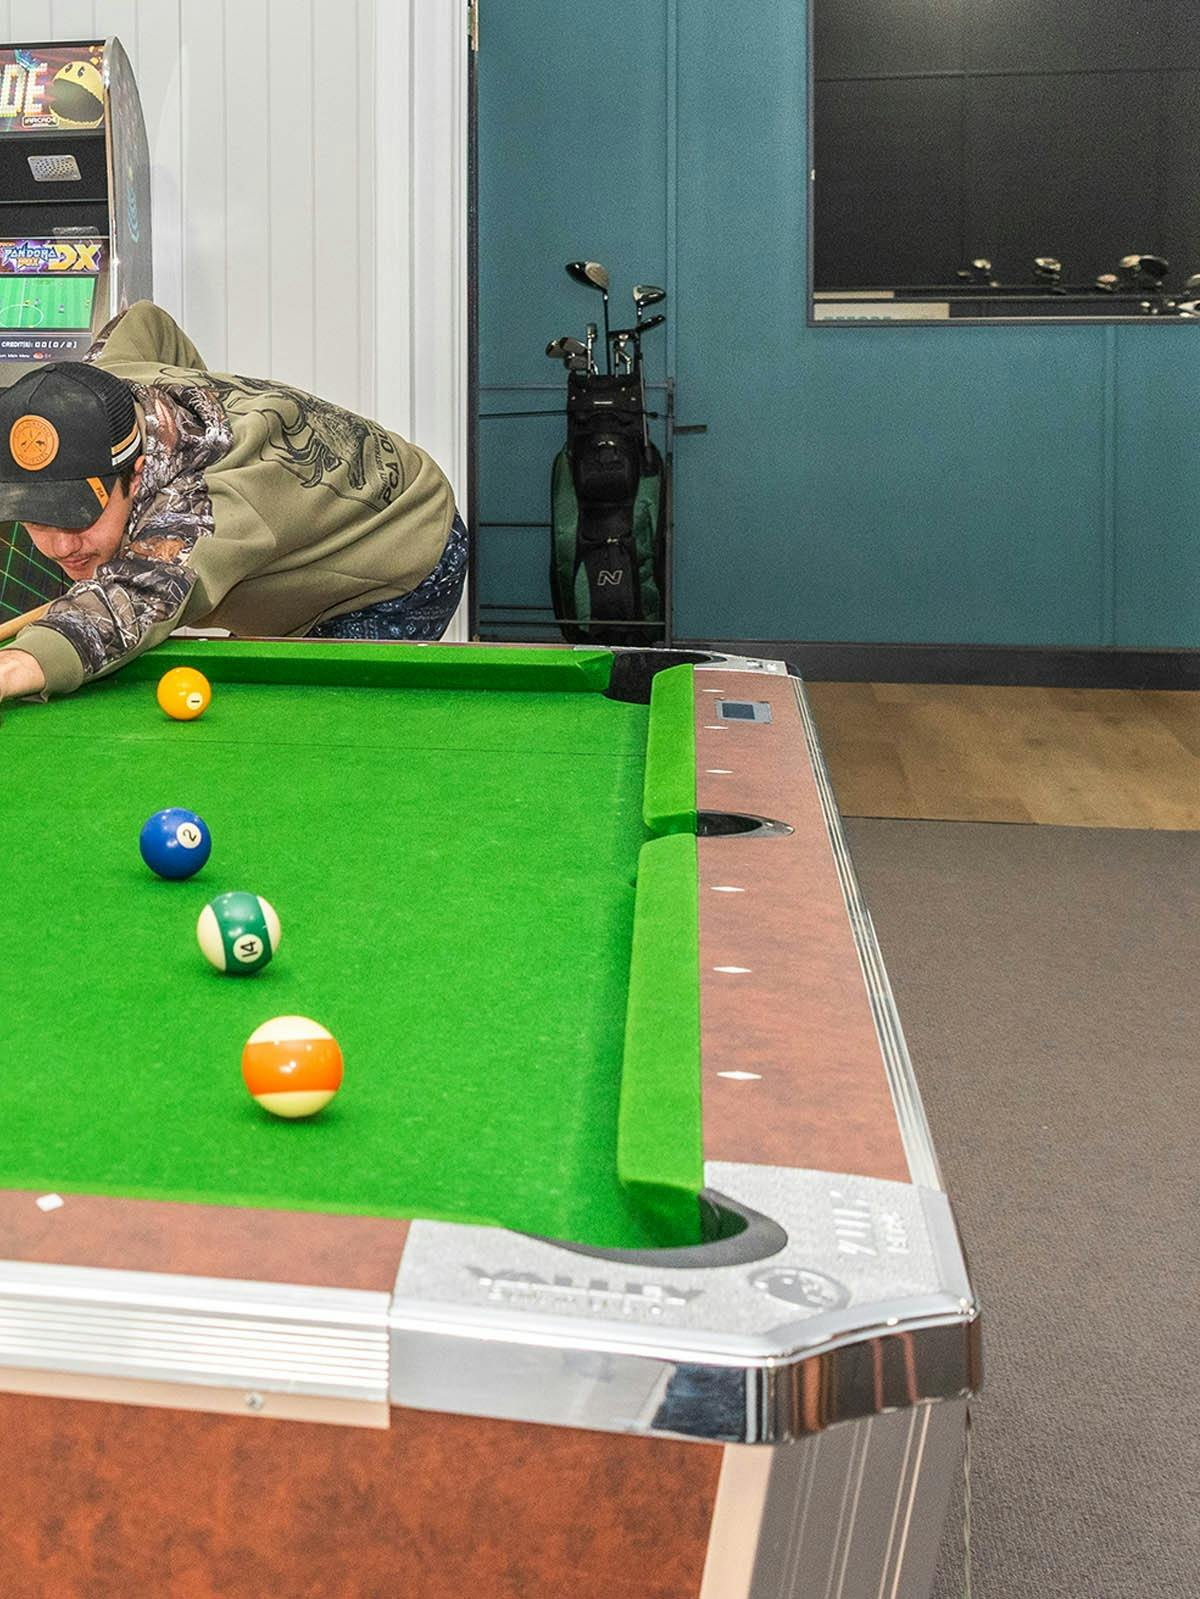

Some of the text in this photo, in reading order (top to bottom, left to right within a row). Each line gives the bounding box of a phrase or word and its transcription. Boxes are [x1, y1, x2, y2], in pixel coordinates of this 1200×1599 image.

[2, 241, 102, 271] PANDORA DX
[383, 461, 400, 505] PCA
[182, 827, 197, 842] 2
[240, 940, 259, 959] 14
